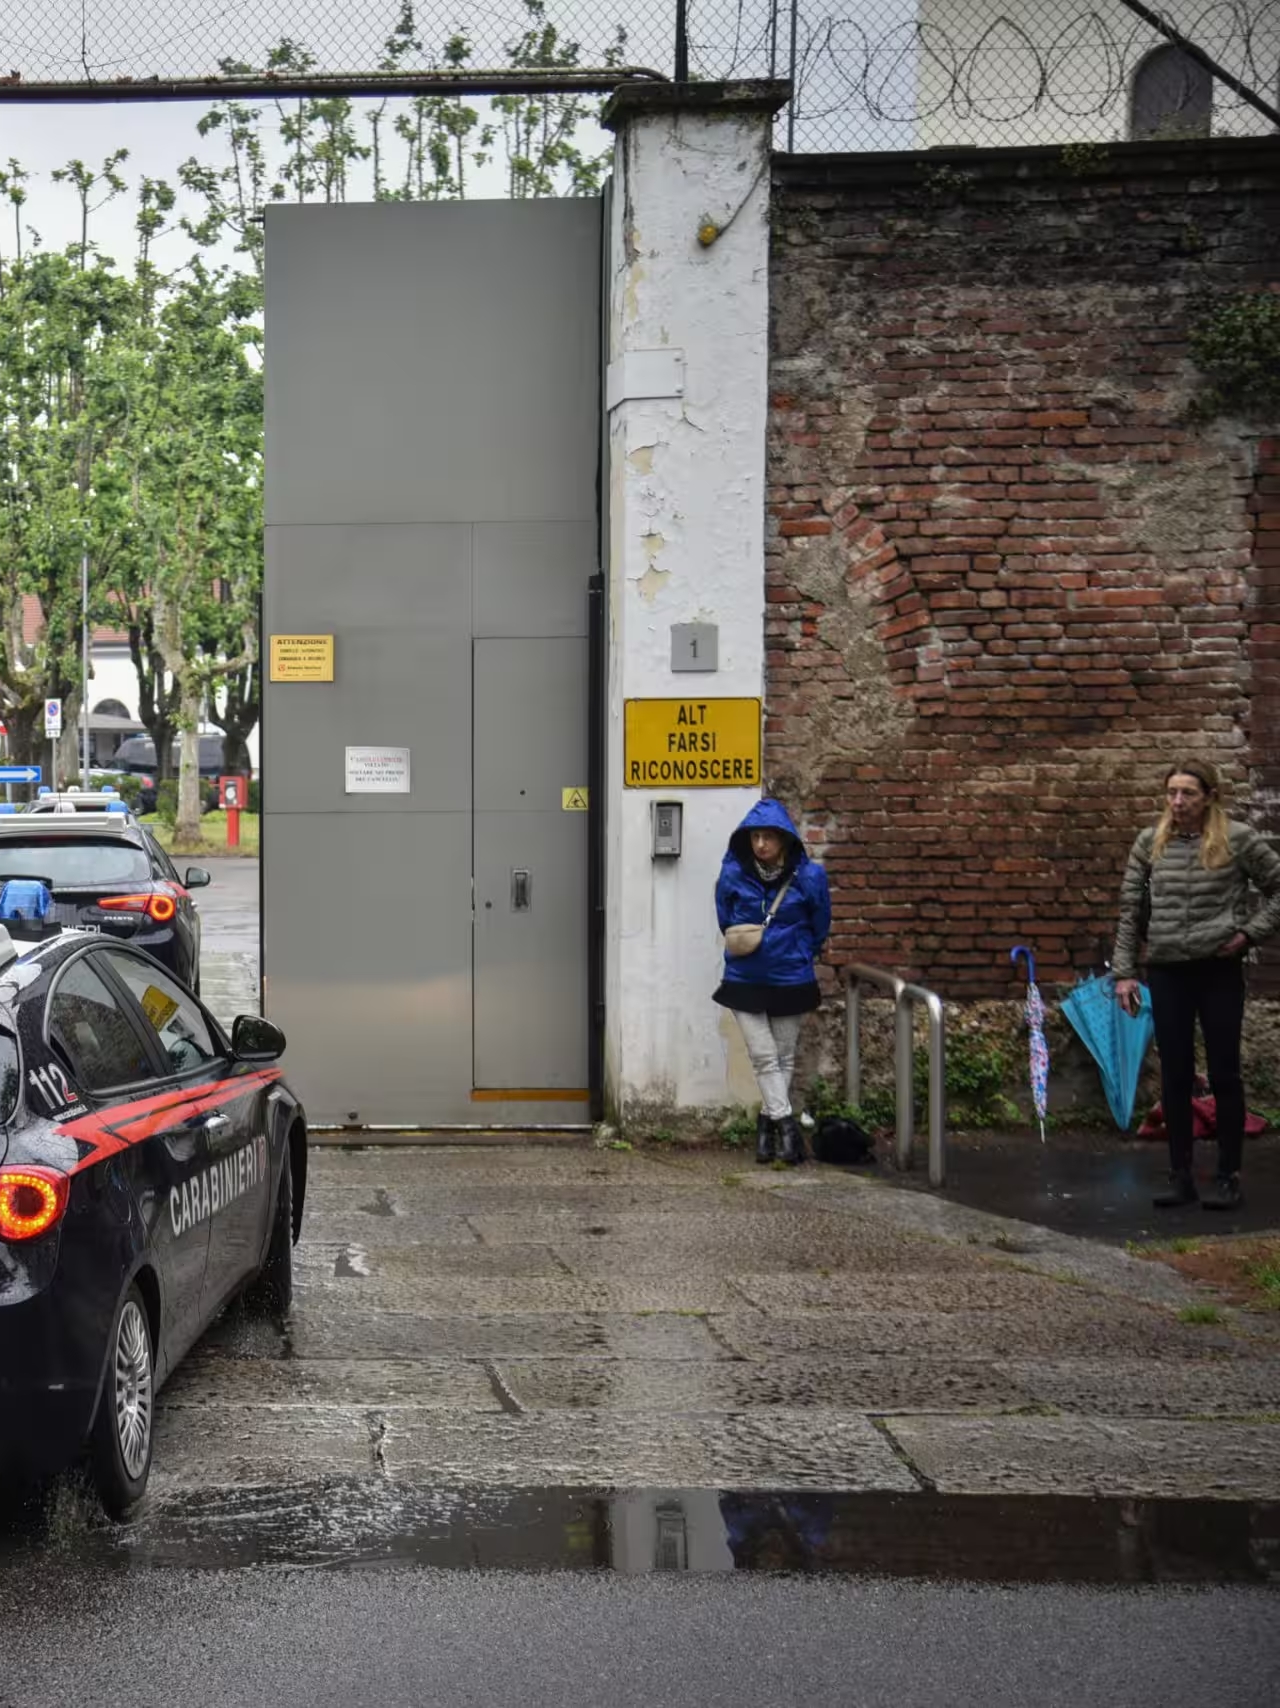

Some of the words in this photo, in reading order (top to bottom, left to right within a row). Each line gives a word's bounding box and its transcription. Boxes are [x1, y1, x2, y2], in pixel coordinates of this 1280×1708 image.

[689, 639, 699, 658] 1
[677, 704, 707, 725] ALT
[668, 732, 716, 753] FARSI
[631, 758, 754, 781] RICONOSCERE
[29, 1062, 78, 1109] 112
[170, 1138, 257, 1237] CARABINIERI
